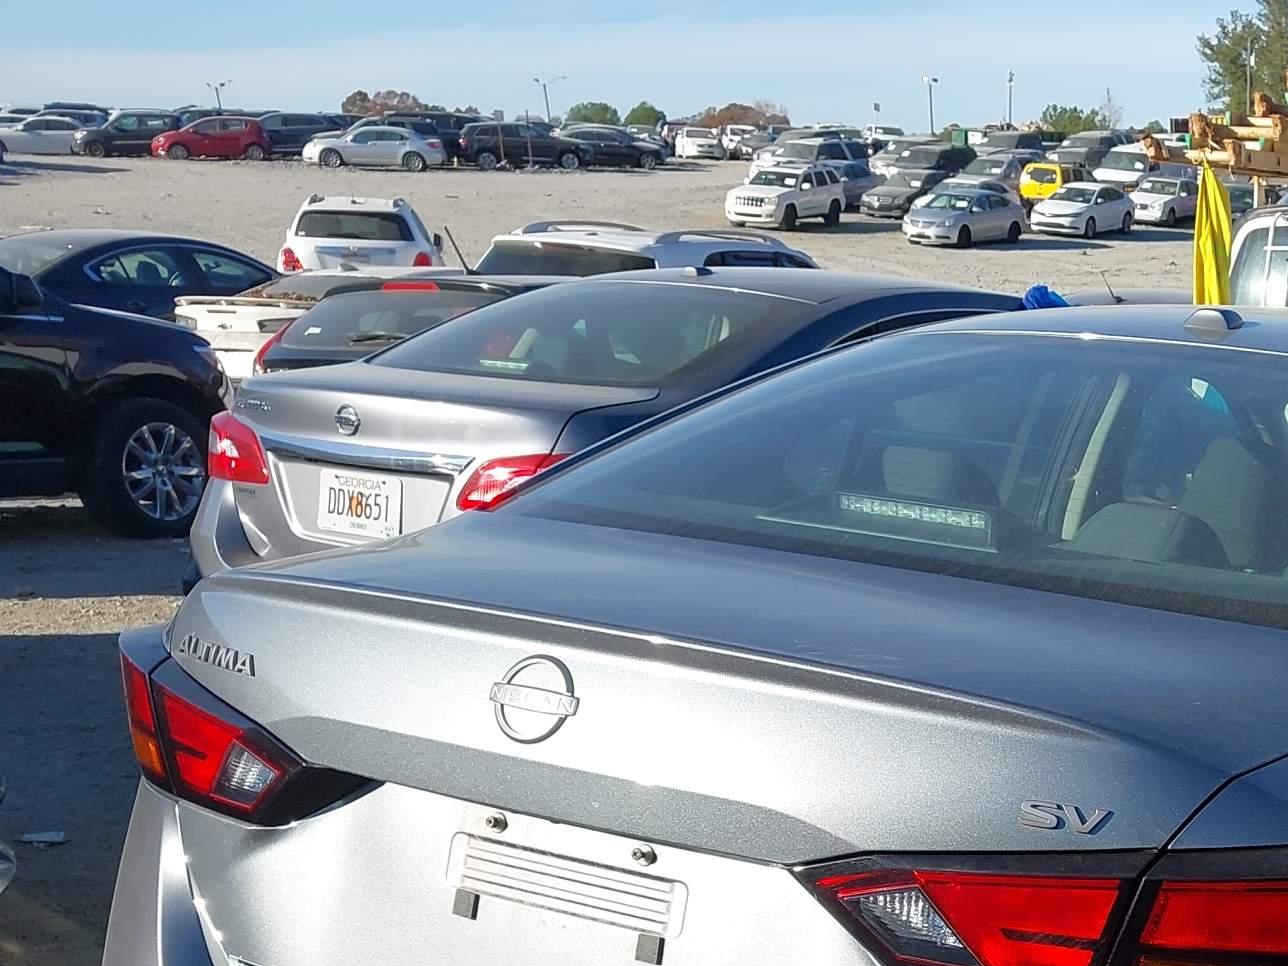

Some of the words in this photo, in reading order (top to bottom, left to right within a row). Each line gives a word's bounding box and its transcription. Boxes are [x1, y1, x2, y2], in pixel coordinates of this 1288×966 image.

[338, 475, 382, 492] GEORGIA
[328, 486, 389, 523] DDX8651
[180, 631, 256, 678] ALTIMA
[1018, 799, 1115, 835] SV
